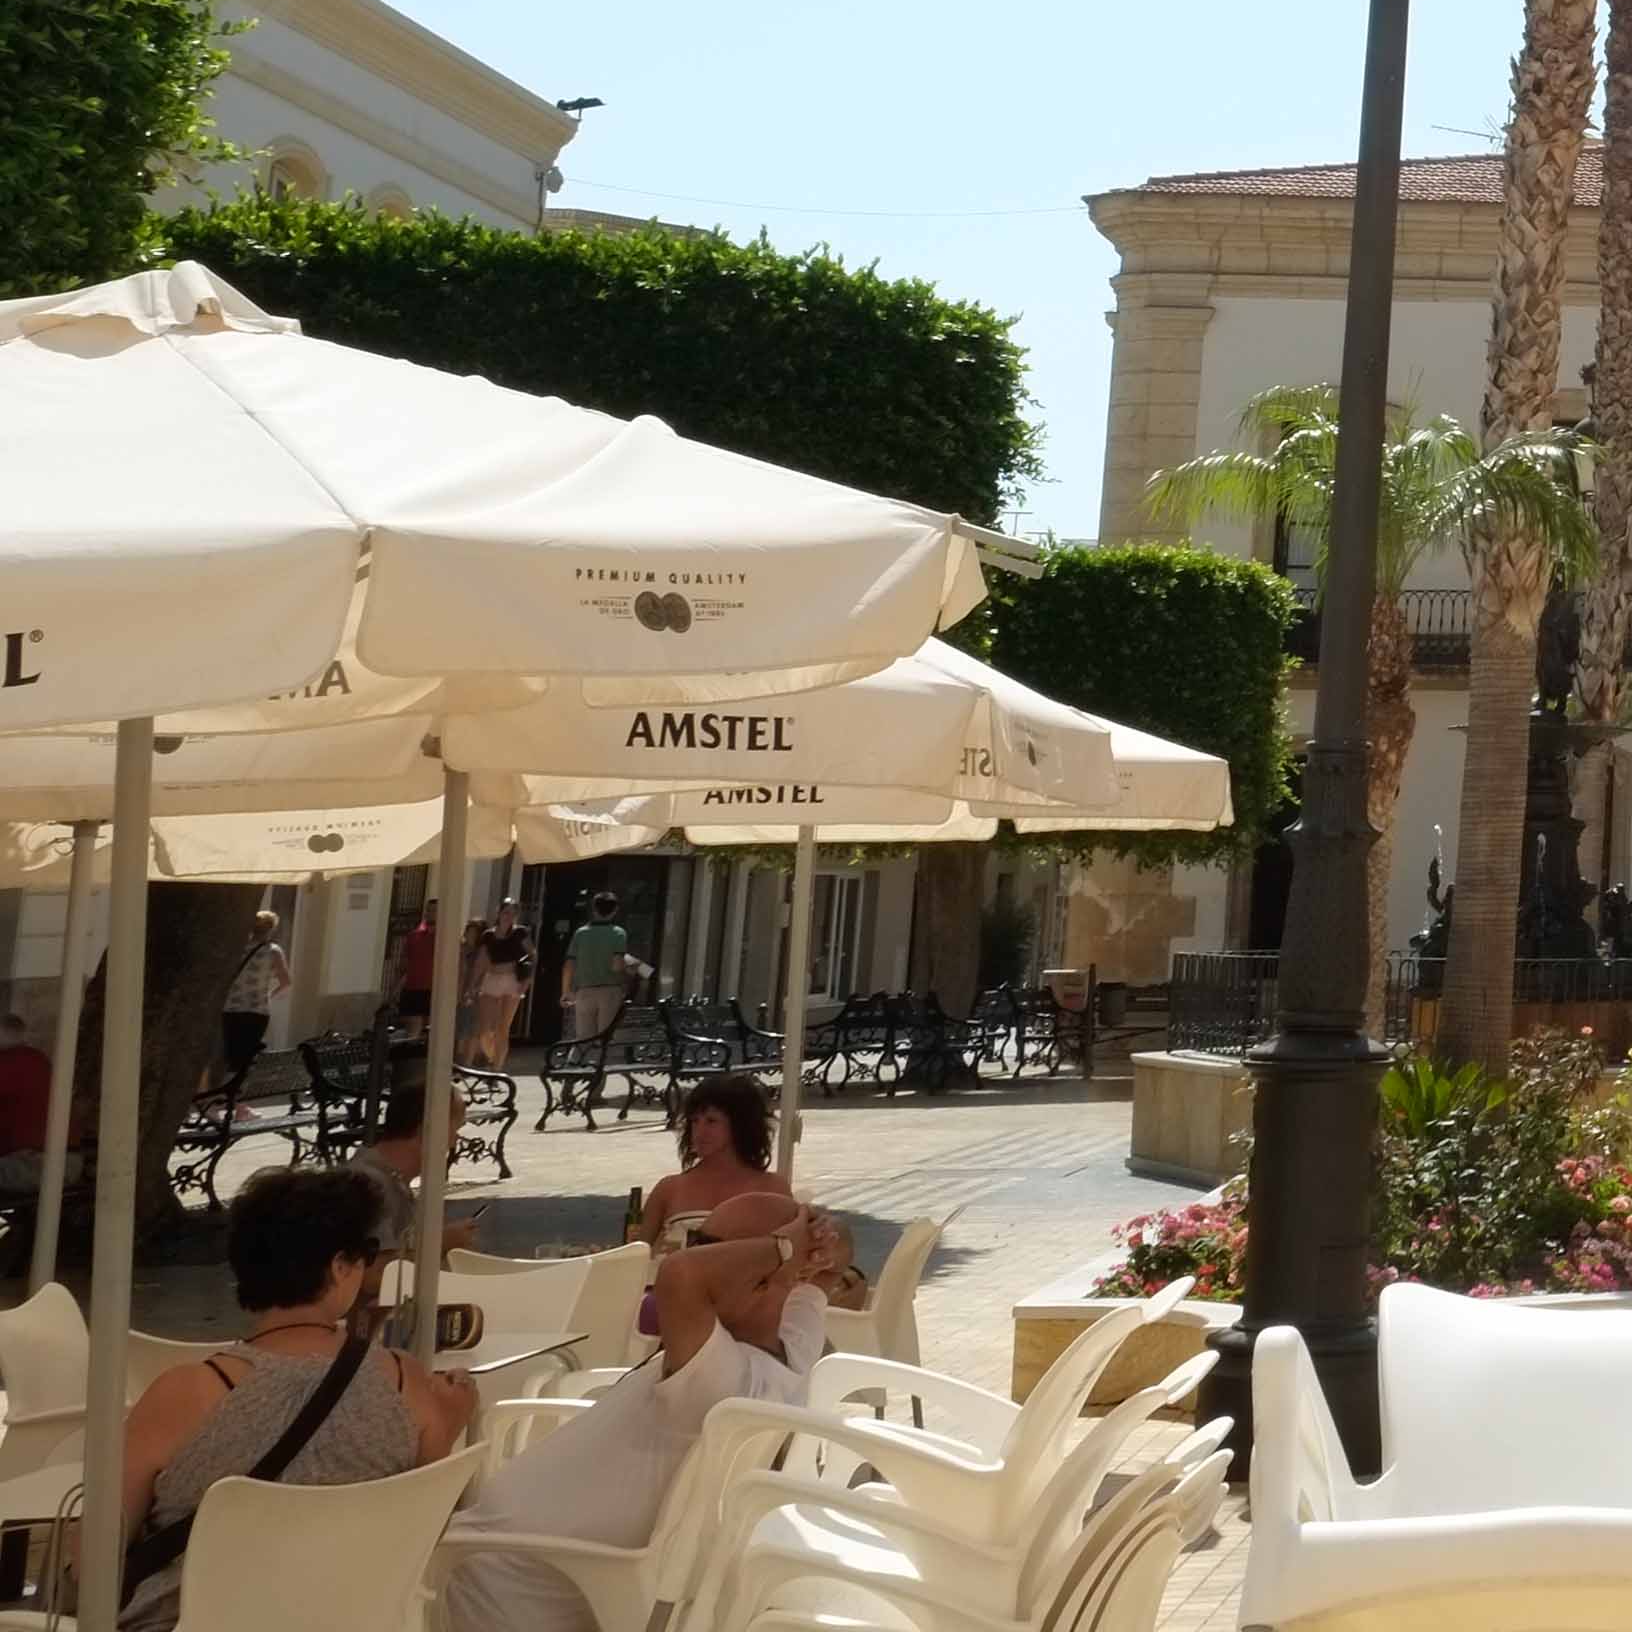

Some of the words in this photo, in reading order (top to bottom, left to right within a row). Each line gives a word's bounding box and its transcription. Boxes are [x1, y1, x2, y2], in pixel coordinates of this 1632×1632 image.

[575, 567, 656, 583] PREMIUM
[668, 572, 746, 585] QUALITY
[625, 711, 793, 751] AMSTEL
